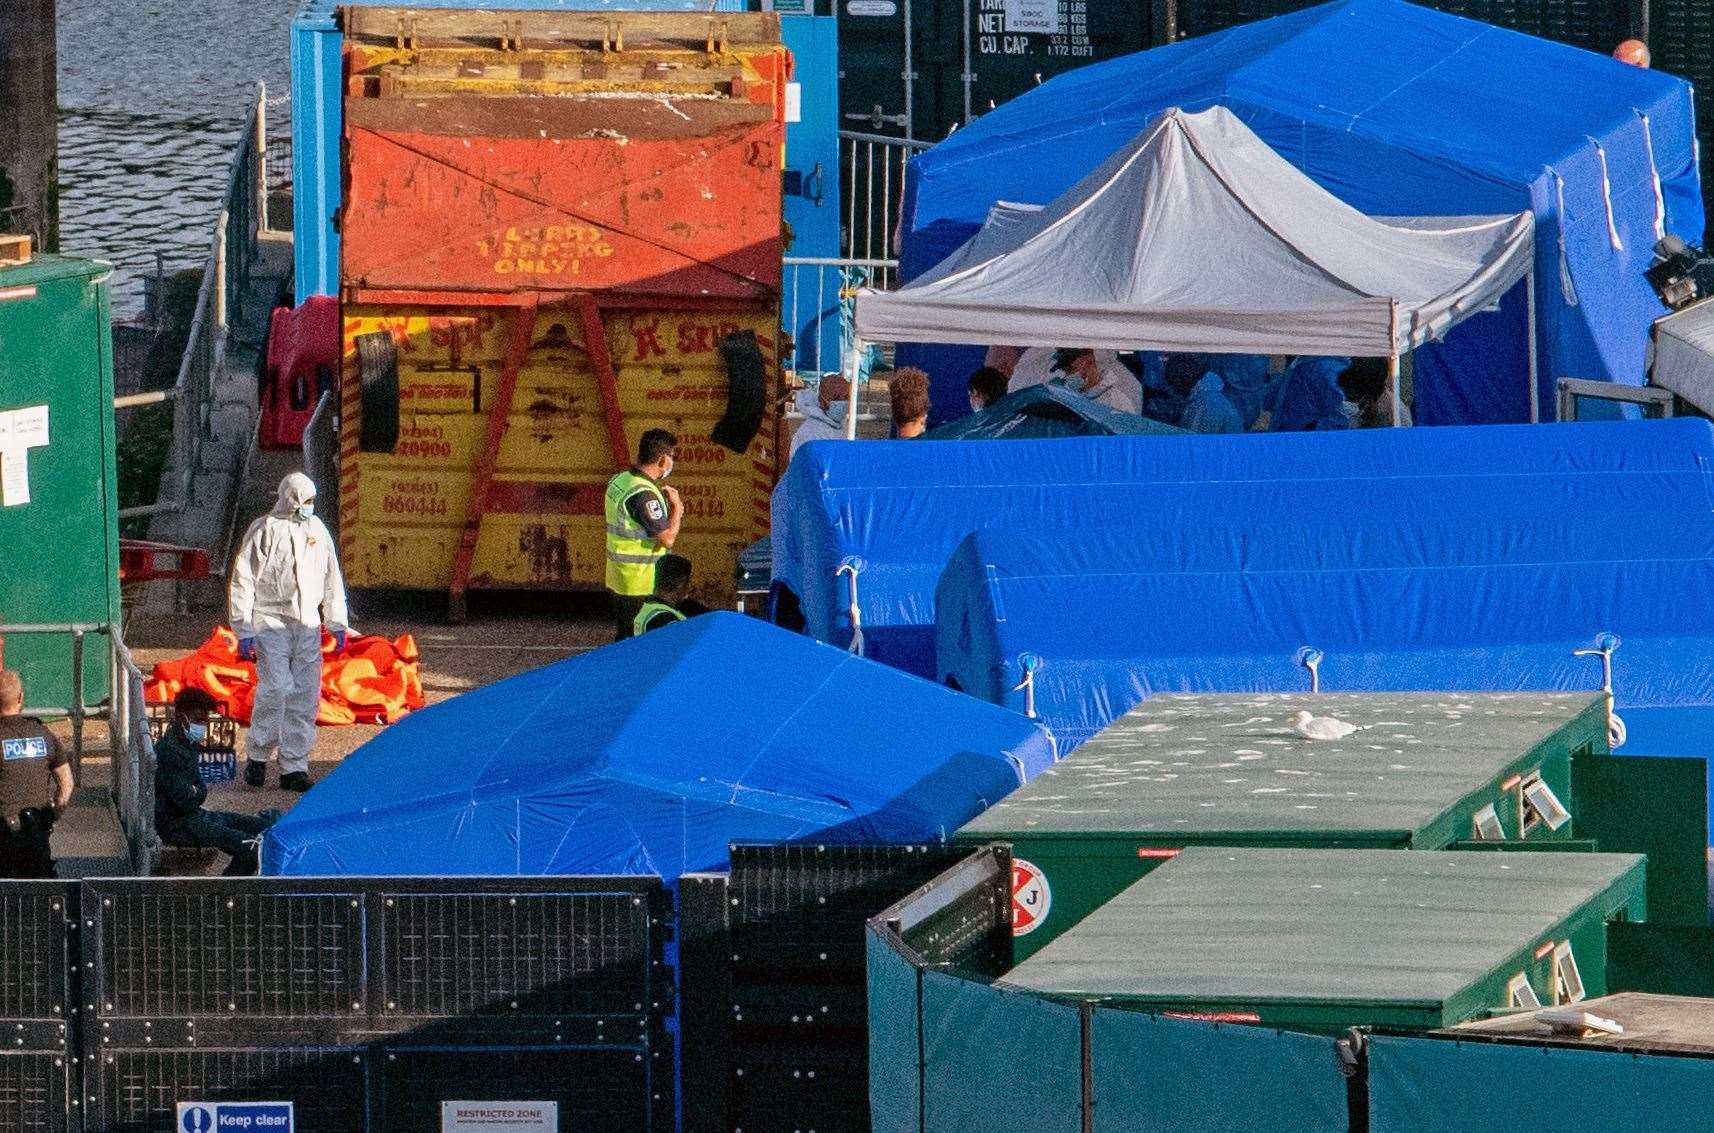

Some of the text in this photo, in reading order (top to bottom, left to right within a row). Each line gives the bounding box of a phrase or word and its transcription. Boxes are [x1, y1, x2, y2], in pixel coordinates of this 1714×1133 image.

[979, 13, 1004, 33] NET
[493, 258, 581, 275] ONLY!
[1026, 890, 1038, 905] J
[220, 1114, 288, 1128] Keep clear
[456, 1110, 543, 1118] RESTRICTED ZONE
